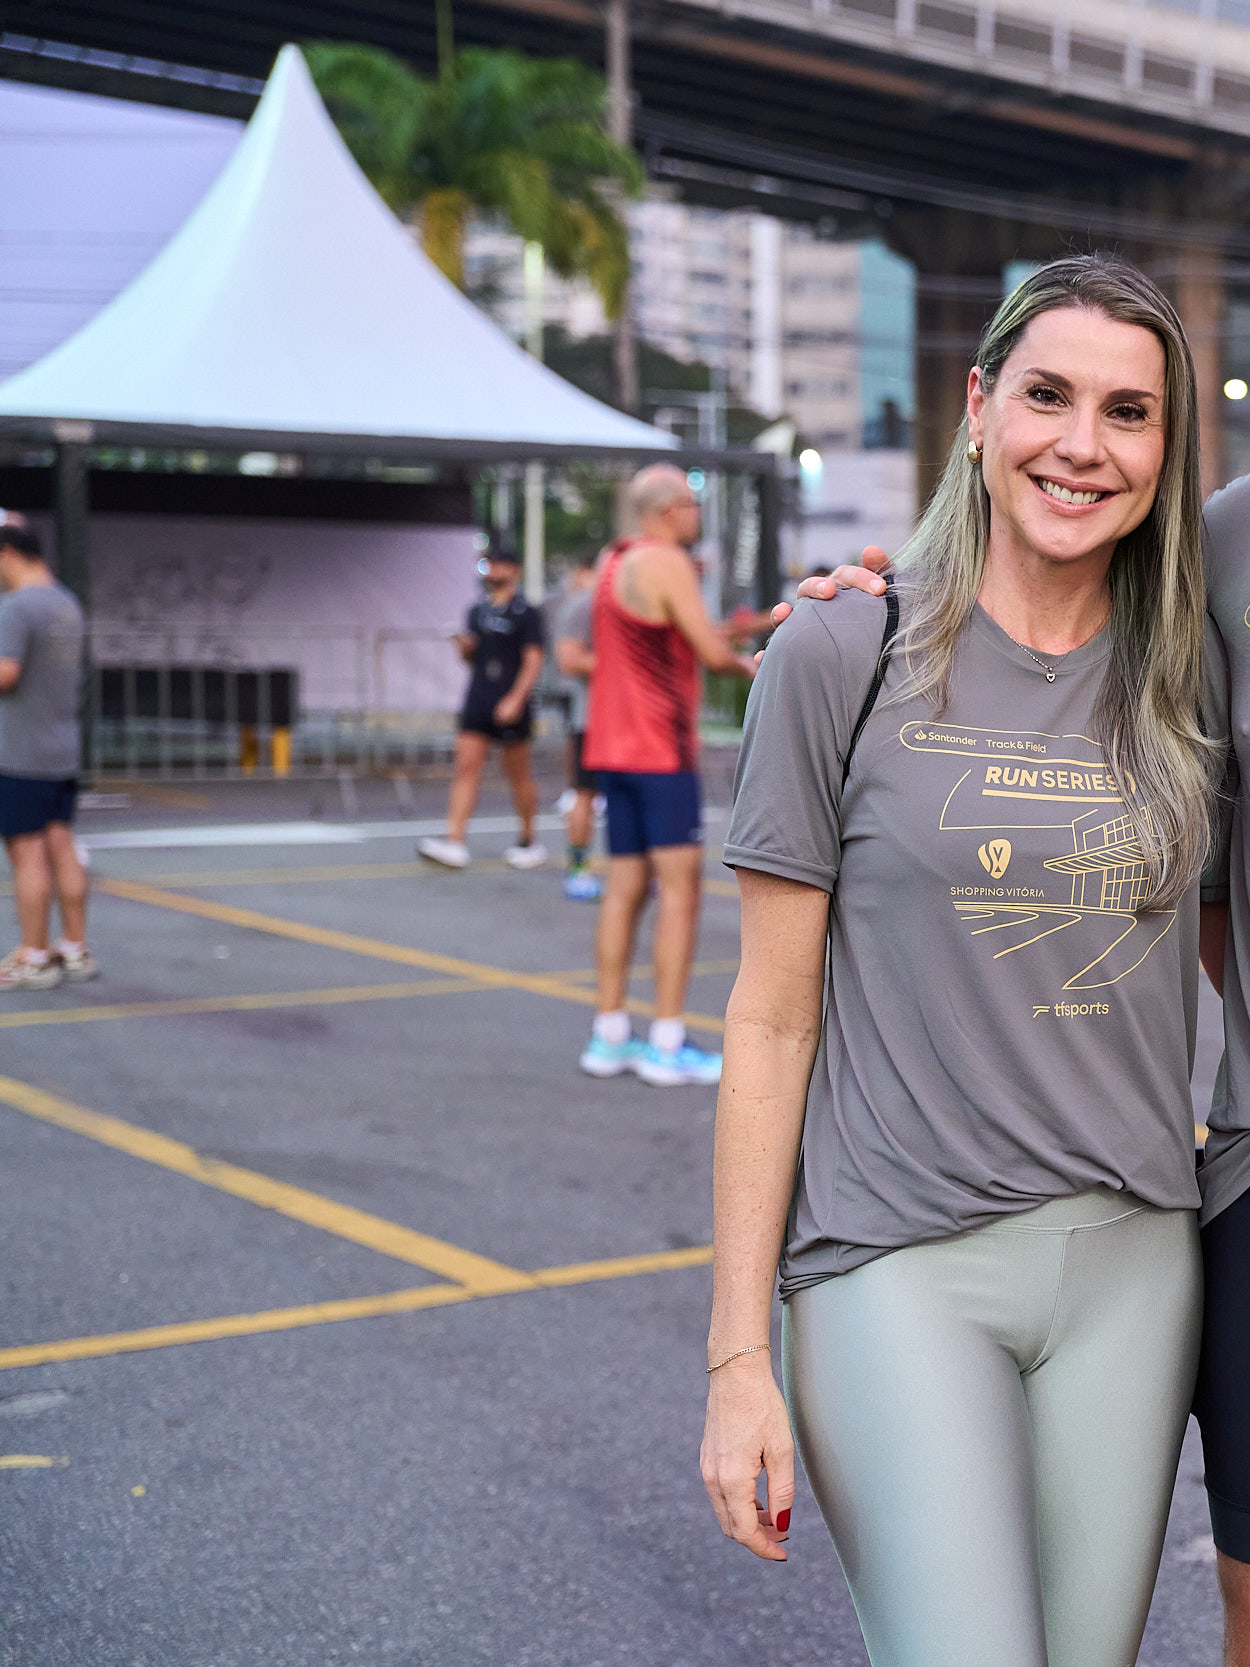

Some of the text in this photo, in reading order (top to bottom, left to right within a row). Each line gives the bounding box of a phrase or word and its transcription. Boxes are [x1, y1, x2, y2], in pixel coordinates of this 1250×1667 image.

[928, 732, 977, 746] Santander
[949, 886, 1045, 898] SHOPPING VITÓRIA
[1054, 1001, 1109, 1018] tfsports
